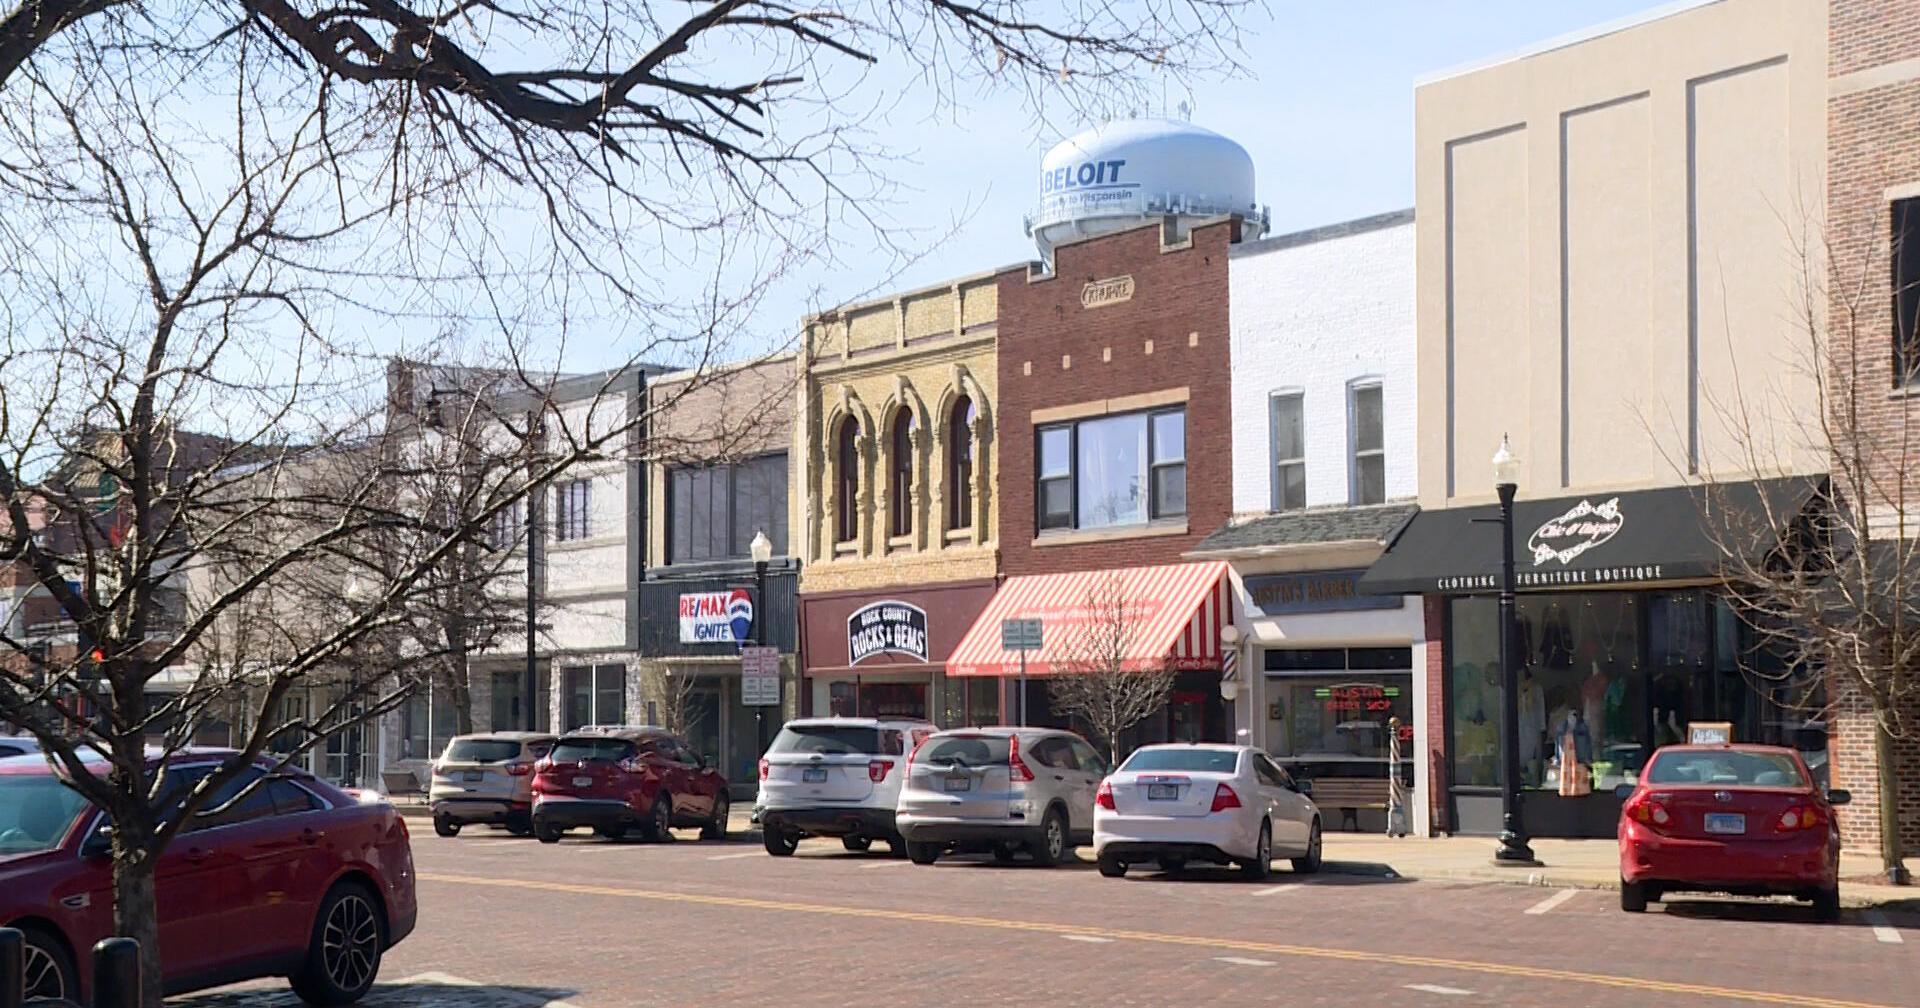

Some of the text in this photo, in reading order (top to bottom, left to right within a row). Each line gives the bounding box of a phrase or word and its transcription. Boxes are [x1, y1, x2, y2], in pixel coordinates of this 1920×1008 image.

[1044, 159, 1126, 193] BELOIT
[1437, 565, 1662, 590] CLOTHING FURNITURE BOUTIQUE
[679, 595, 727, 618] RE/MAX
[861, 607, 912, 627] ROCK COUNTY
[694, 623, 729, 640] IGNITE
[851, 623, 924, 658] ROCKS & GEMS
[1330, 686, 1383, 698] AUSTIN
